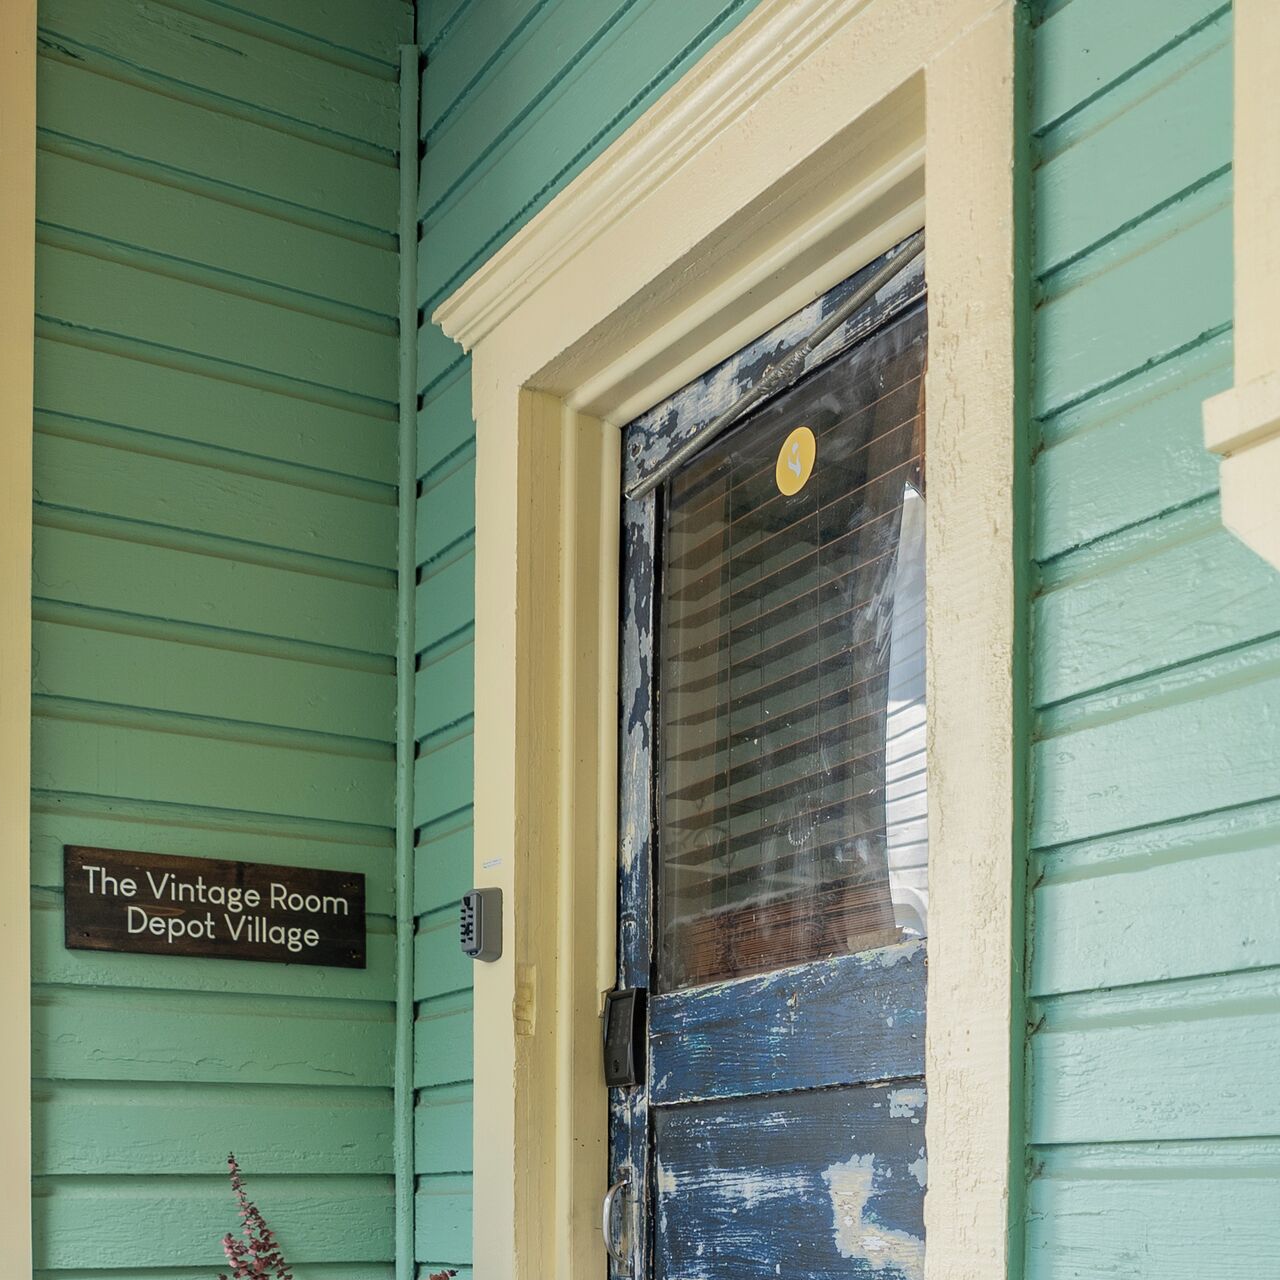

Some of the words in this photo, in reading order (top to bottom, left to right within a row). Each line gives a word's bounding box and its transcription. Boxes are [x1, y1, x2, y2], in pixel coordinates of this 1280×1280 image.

[82, 865, 138, 897] The
[146, 871, 261, 913] Vintage
[270, 883, 349, 916] Room
[127, 906, 216, 944] Depot
[224, 913, 320, 952] Village
